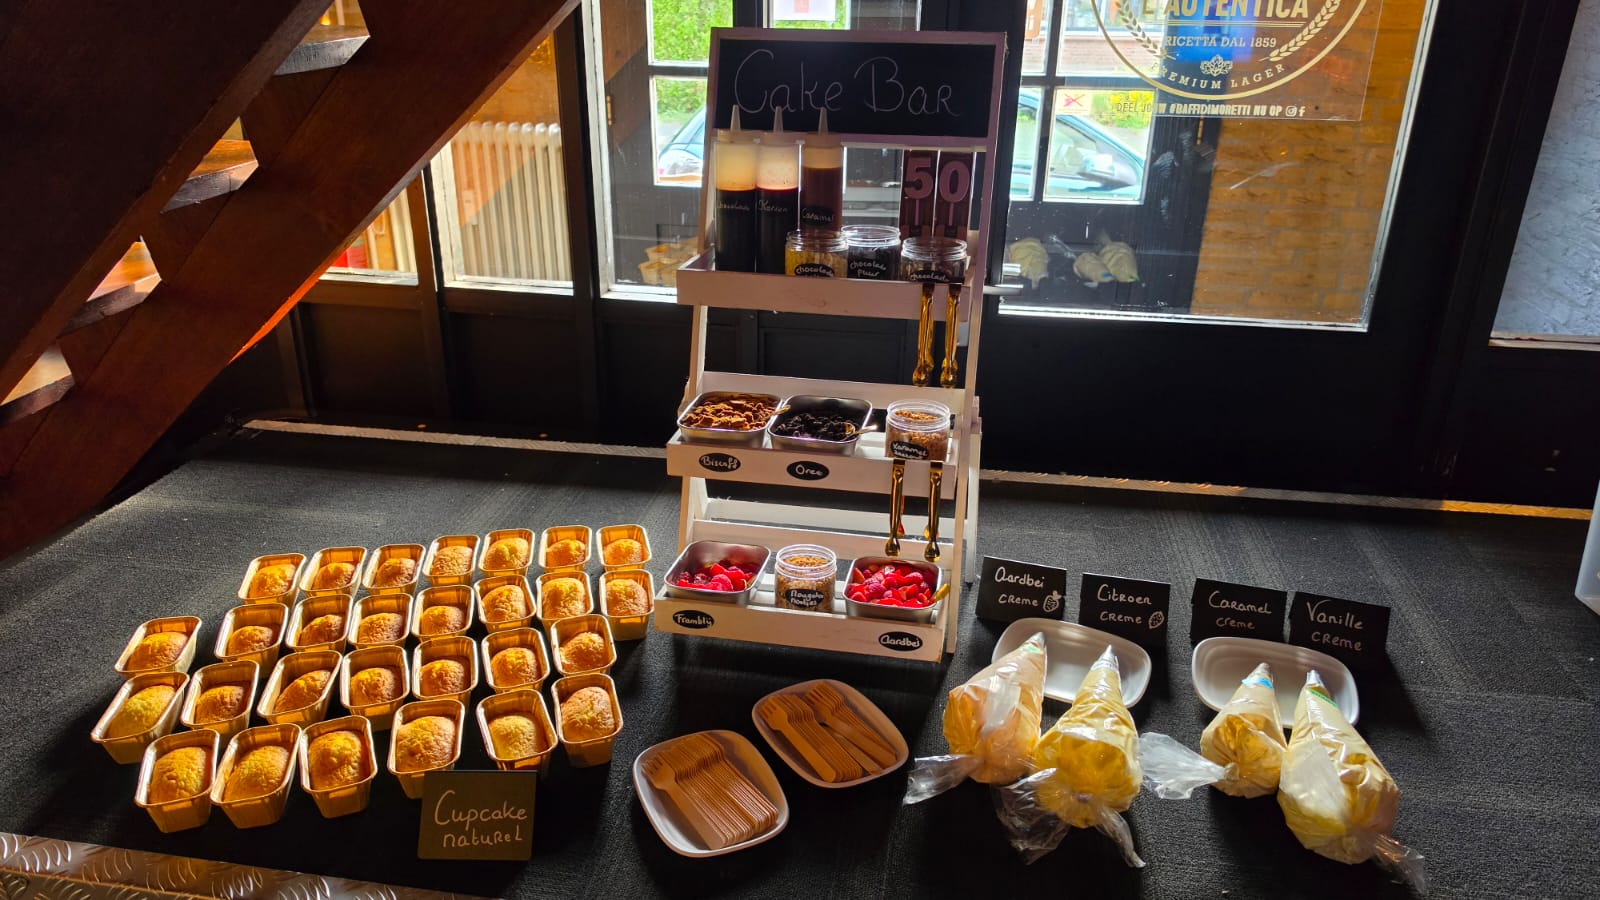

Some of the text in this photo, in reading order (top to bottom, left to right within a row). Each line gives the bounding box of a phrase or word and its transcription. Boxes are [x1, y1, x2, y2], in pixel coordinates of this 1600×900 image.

[1165, 36, 1277, 48] RICETTA DAL 1859
[734, 49, 843, 113] Cake
[1151, 60, 1285, 89] PREMIUM LAGER
[1117, 102, 1138, 113] DEEL
[1141, 102, 1167, 114] JOW
[1253, 104, 1266, 116] NU
[1269, 105, 1283, 117] OP
[904, 157, 970, 203] 50
[994, 566, 1045, 588] Aardbei
[1307, 599, 1364, 630] Vanille
[880, 634, 920, 648] Aardbei
[434, 789, 528, 831] Cupcake
